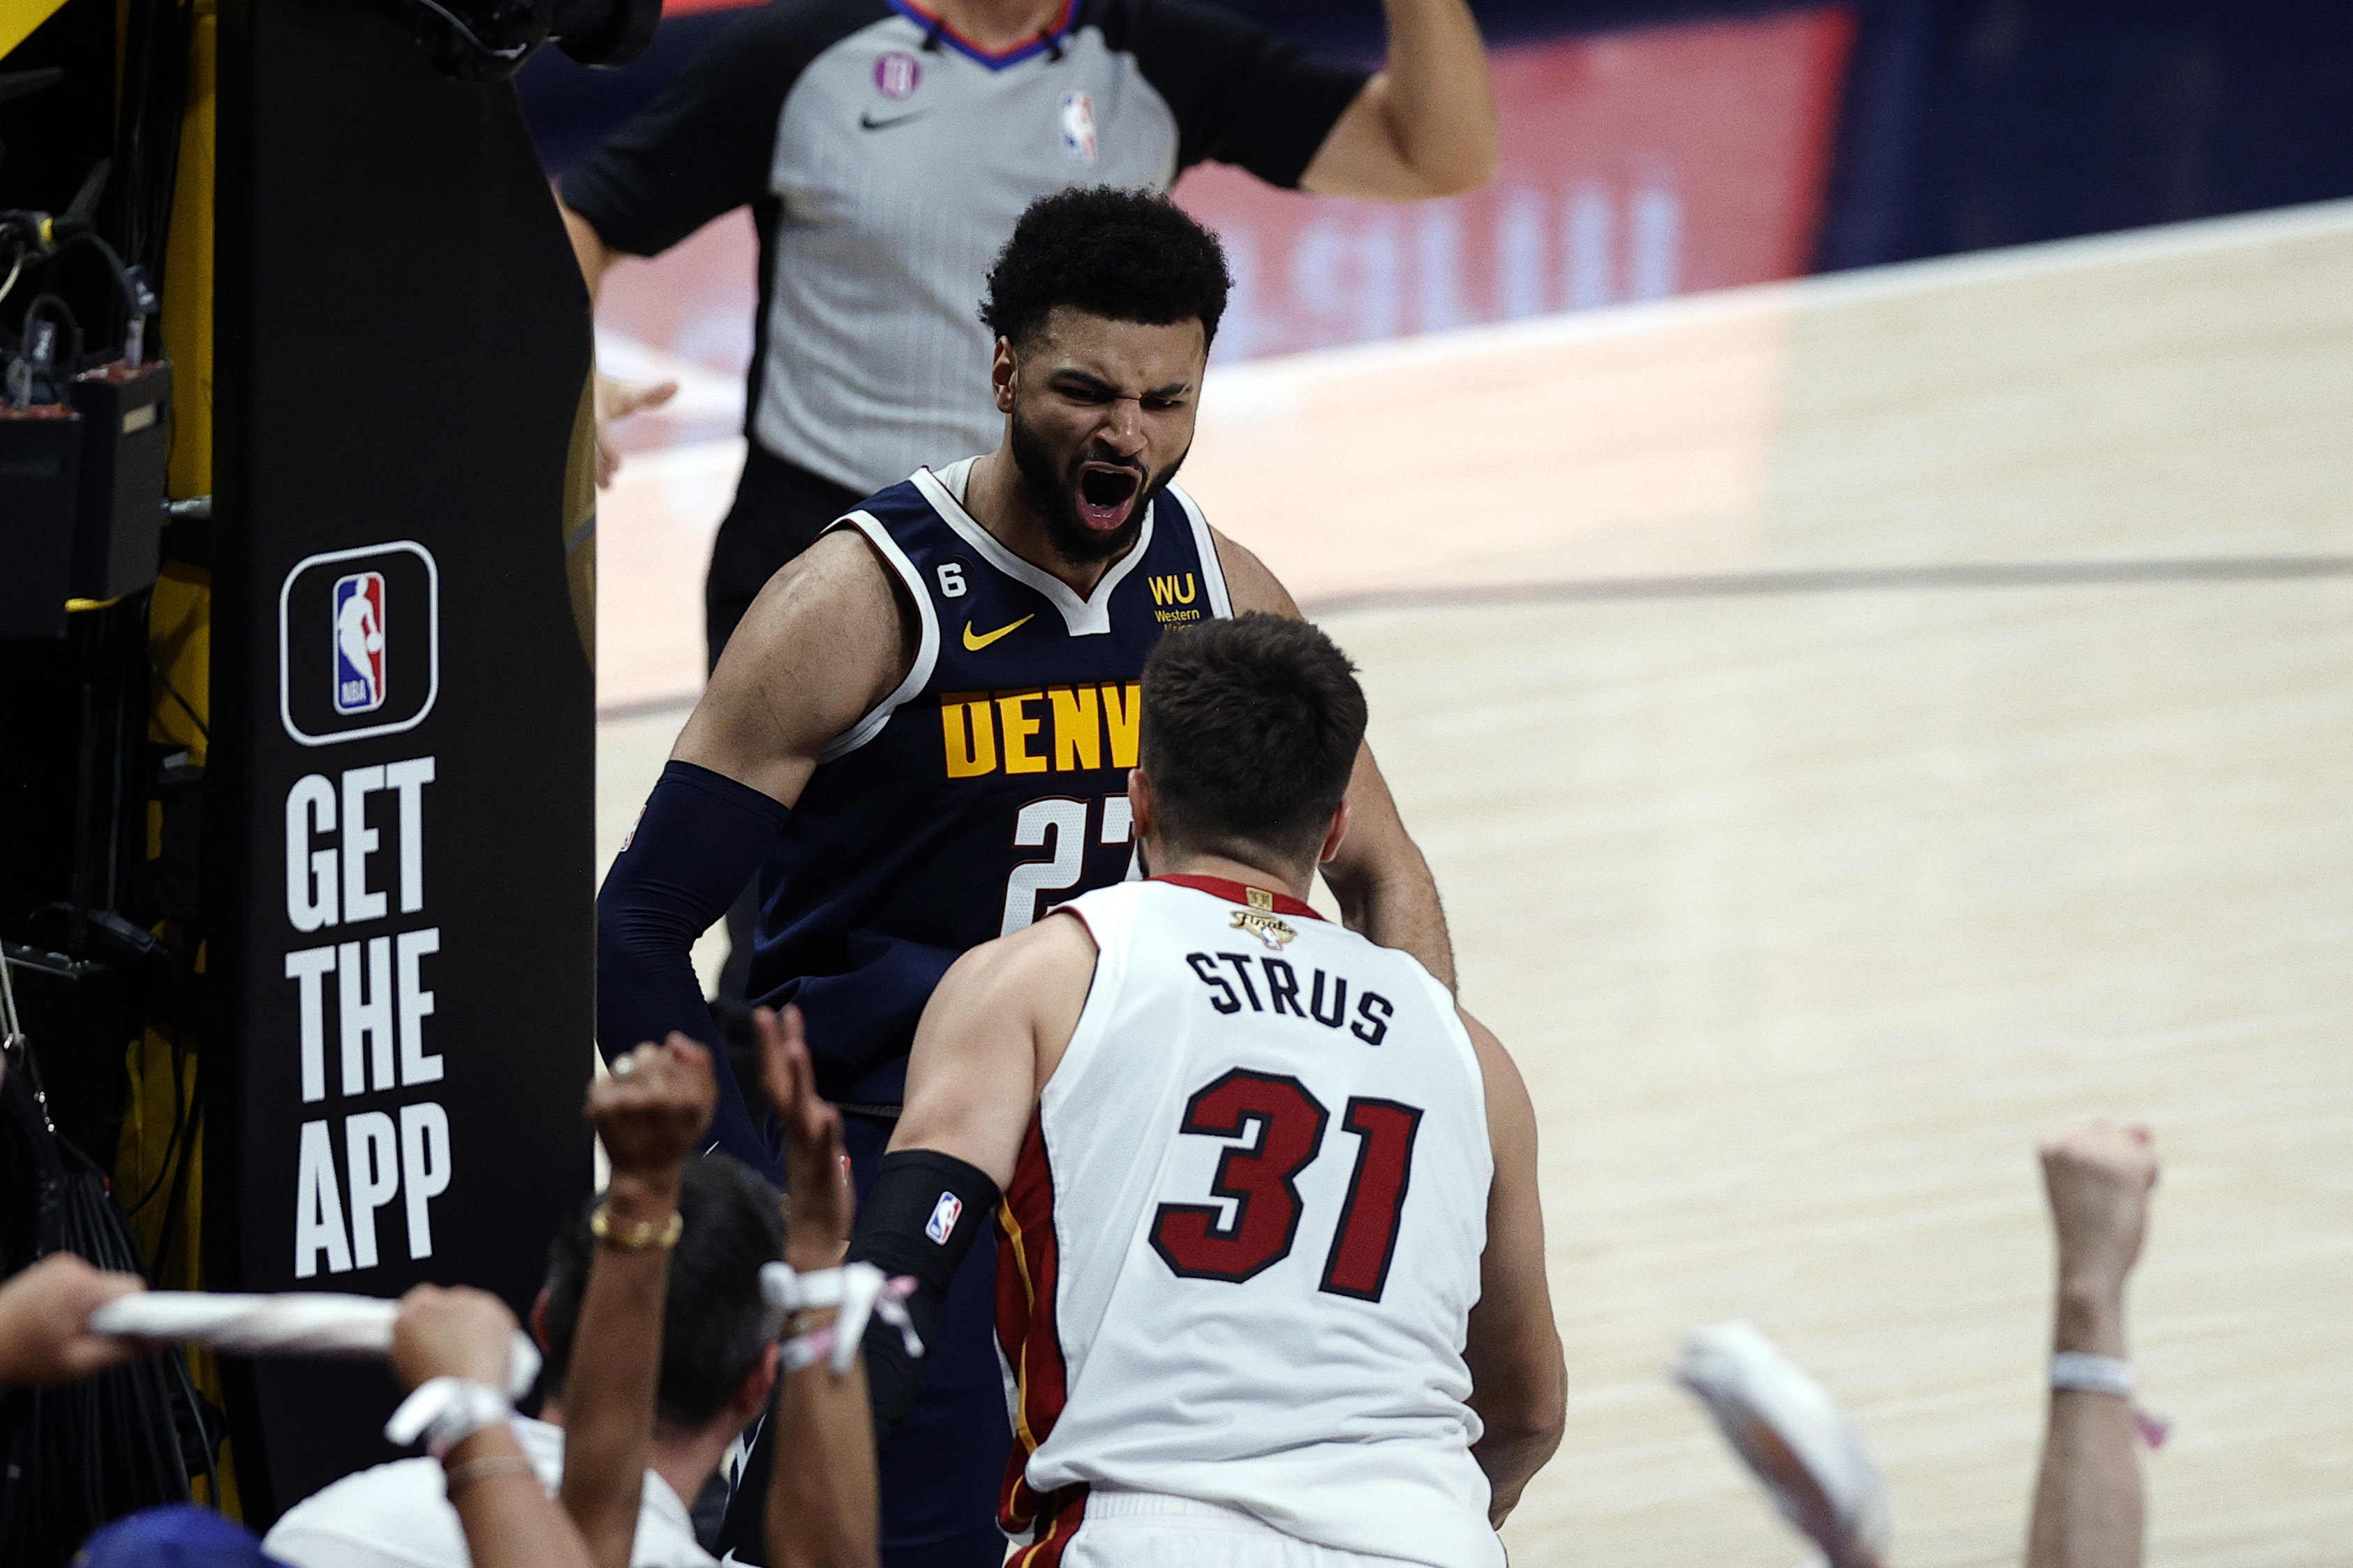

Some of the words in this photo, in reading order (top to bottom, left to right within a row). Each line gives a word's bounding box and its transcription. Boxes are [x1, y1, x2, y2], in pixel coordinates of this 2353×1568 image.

[937, 562, 967, 598] 6
[1148, 572, 1196, 606] WU
[1154, 609, 1200, 622] Western
[285, 756, 436, 933] GET
[285, 927, 445, 1104] THE
[1186, 952, 1395, 1046] STRUS
[295, 1101, 452, 1279] APP
[1148, 1066, 1425, 1304] 31
